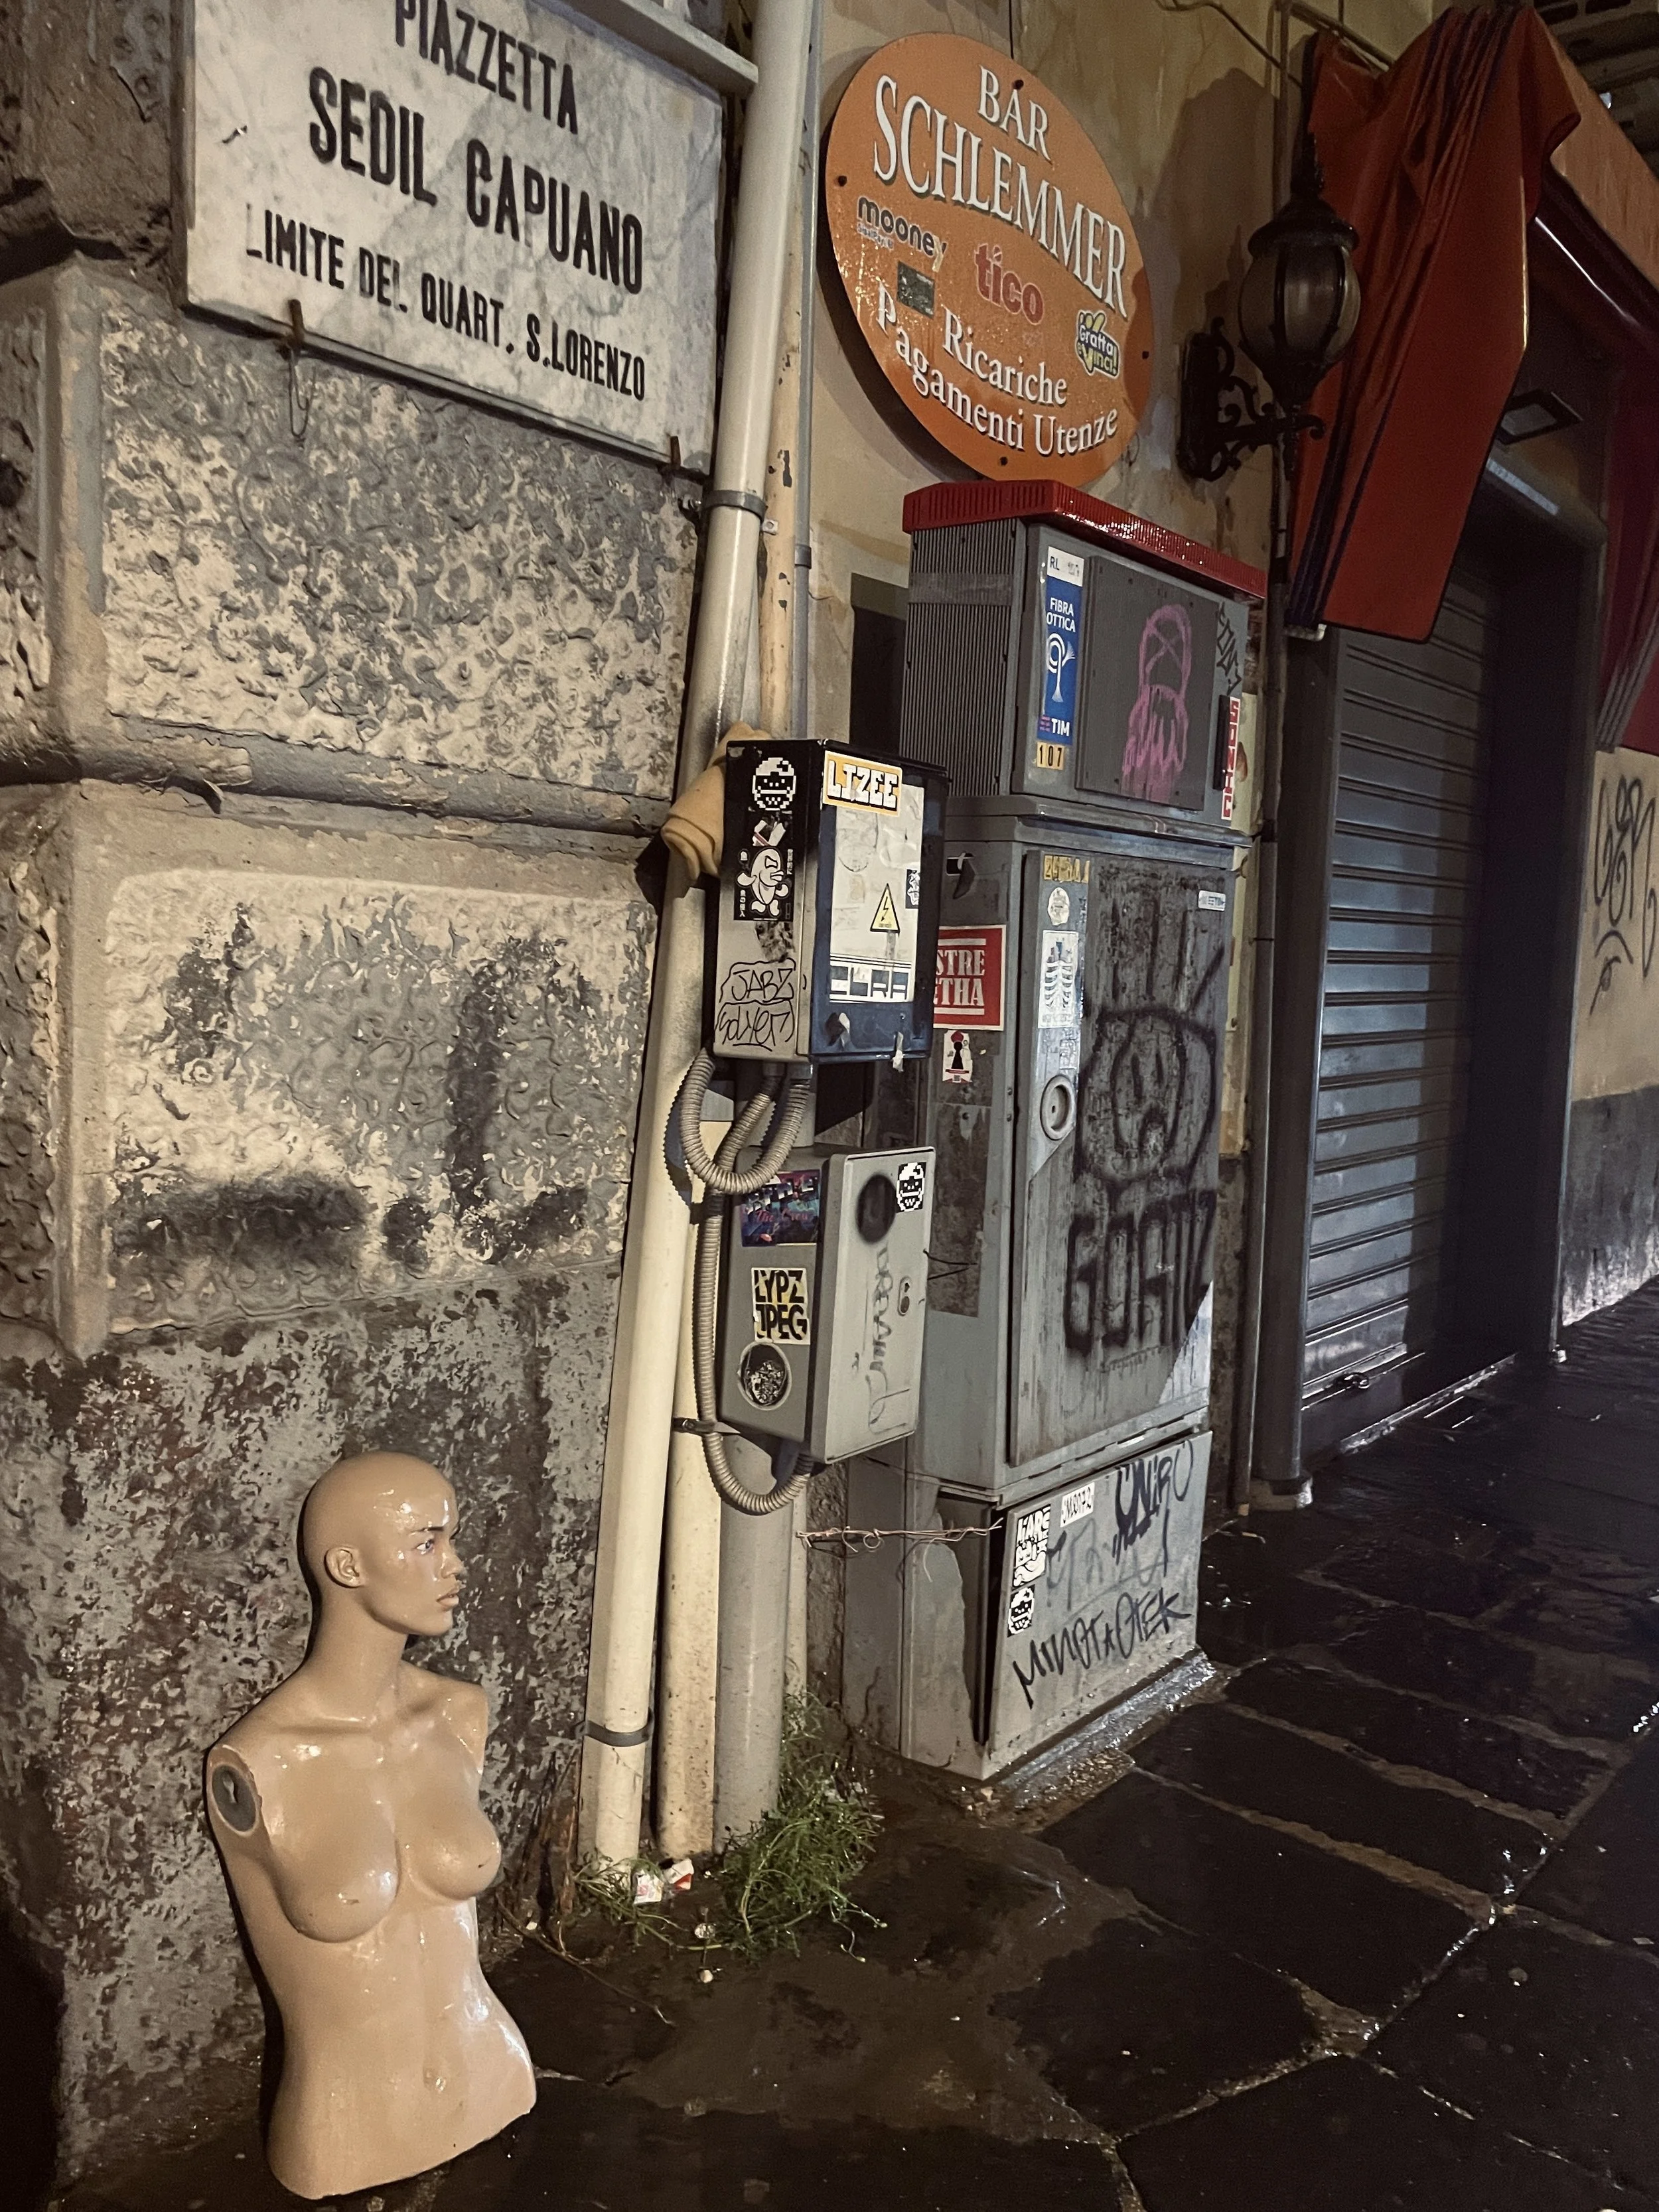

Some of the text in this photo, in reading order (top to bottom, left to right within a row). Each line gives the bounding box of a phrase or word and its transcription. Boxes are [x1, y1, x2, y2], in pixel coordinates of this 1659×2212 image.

[396, 0, 579, 134] PIAZZETTA
[977, 65, 1052, 161] BAR
[309, 66, 643, 295] SEDIL CAPUANO
[873, 74, 1128, 318] SCHLEMMER
[858, 196, 948, 273] mooney
[246, 203, 345, 290] LIMITE
[359, 247, 407, 313] DEL
[421, 273, 516, 354] QUART.
[974, 244, 1045, 326] tico
[875, 275, 1119, 457] Pagamenti Utenze
[942, 304, 1068, 405] Ricariche
[1080, 324, 1114, 356] Gratta
[1046, 612, 1076, 633] OTTICA
[1050, 597, 1074, 616] FIBRA
[1039, 744, 1062, 767] 107
[1051, 718, 1070, 736] TIM
[827, 760, 899, 811] LIZEE
[754, 1270, 805, 1303] LYPZ
[756, 1304, 808, 1340] JPEG
